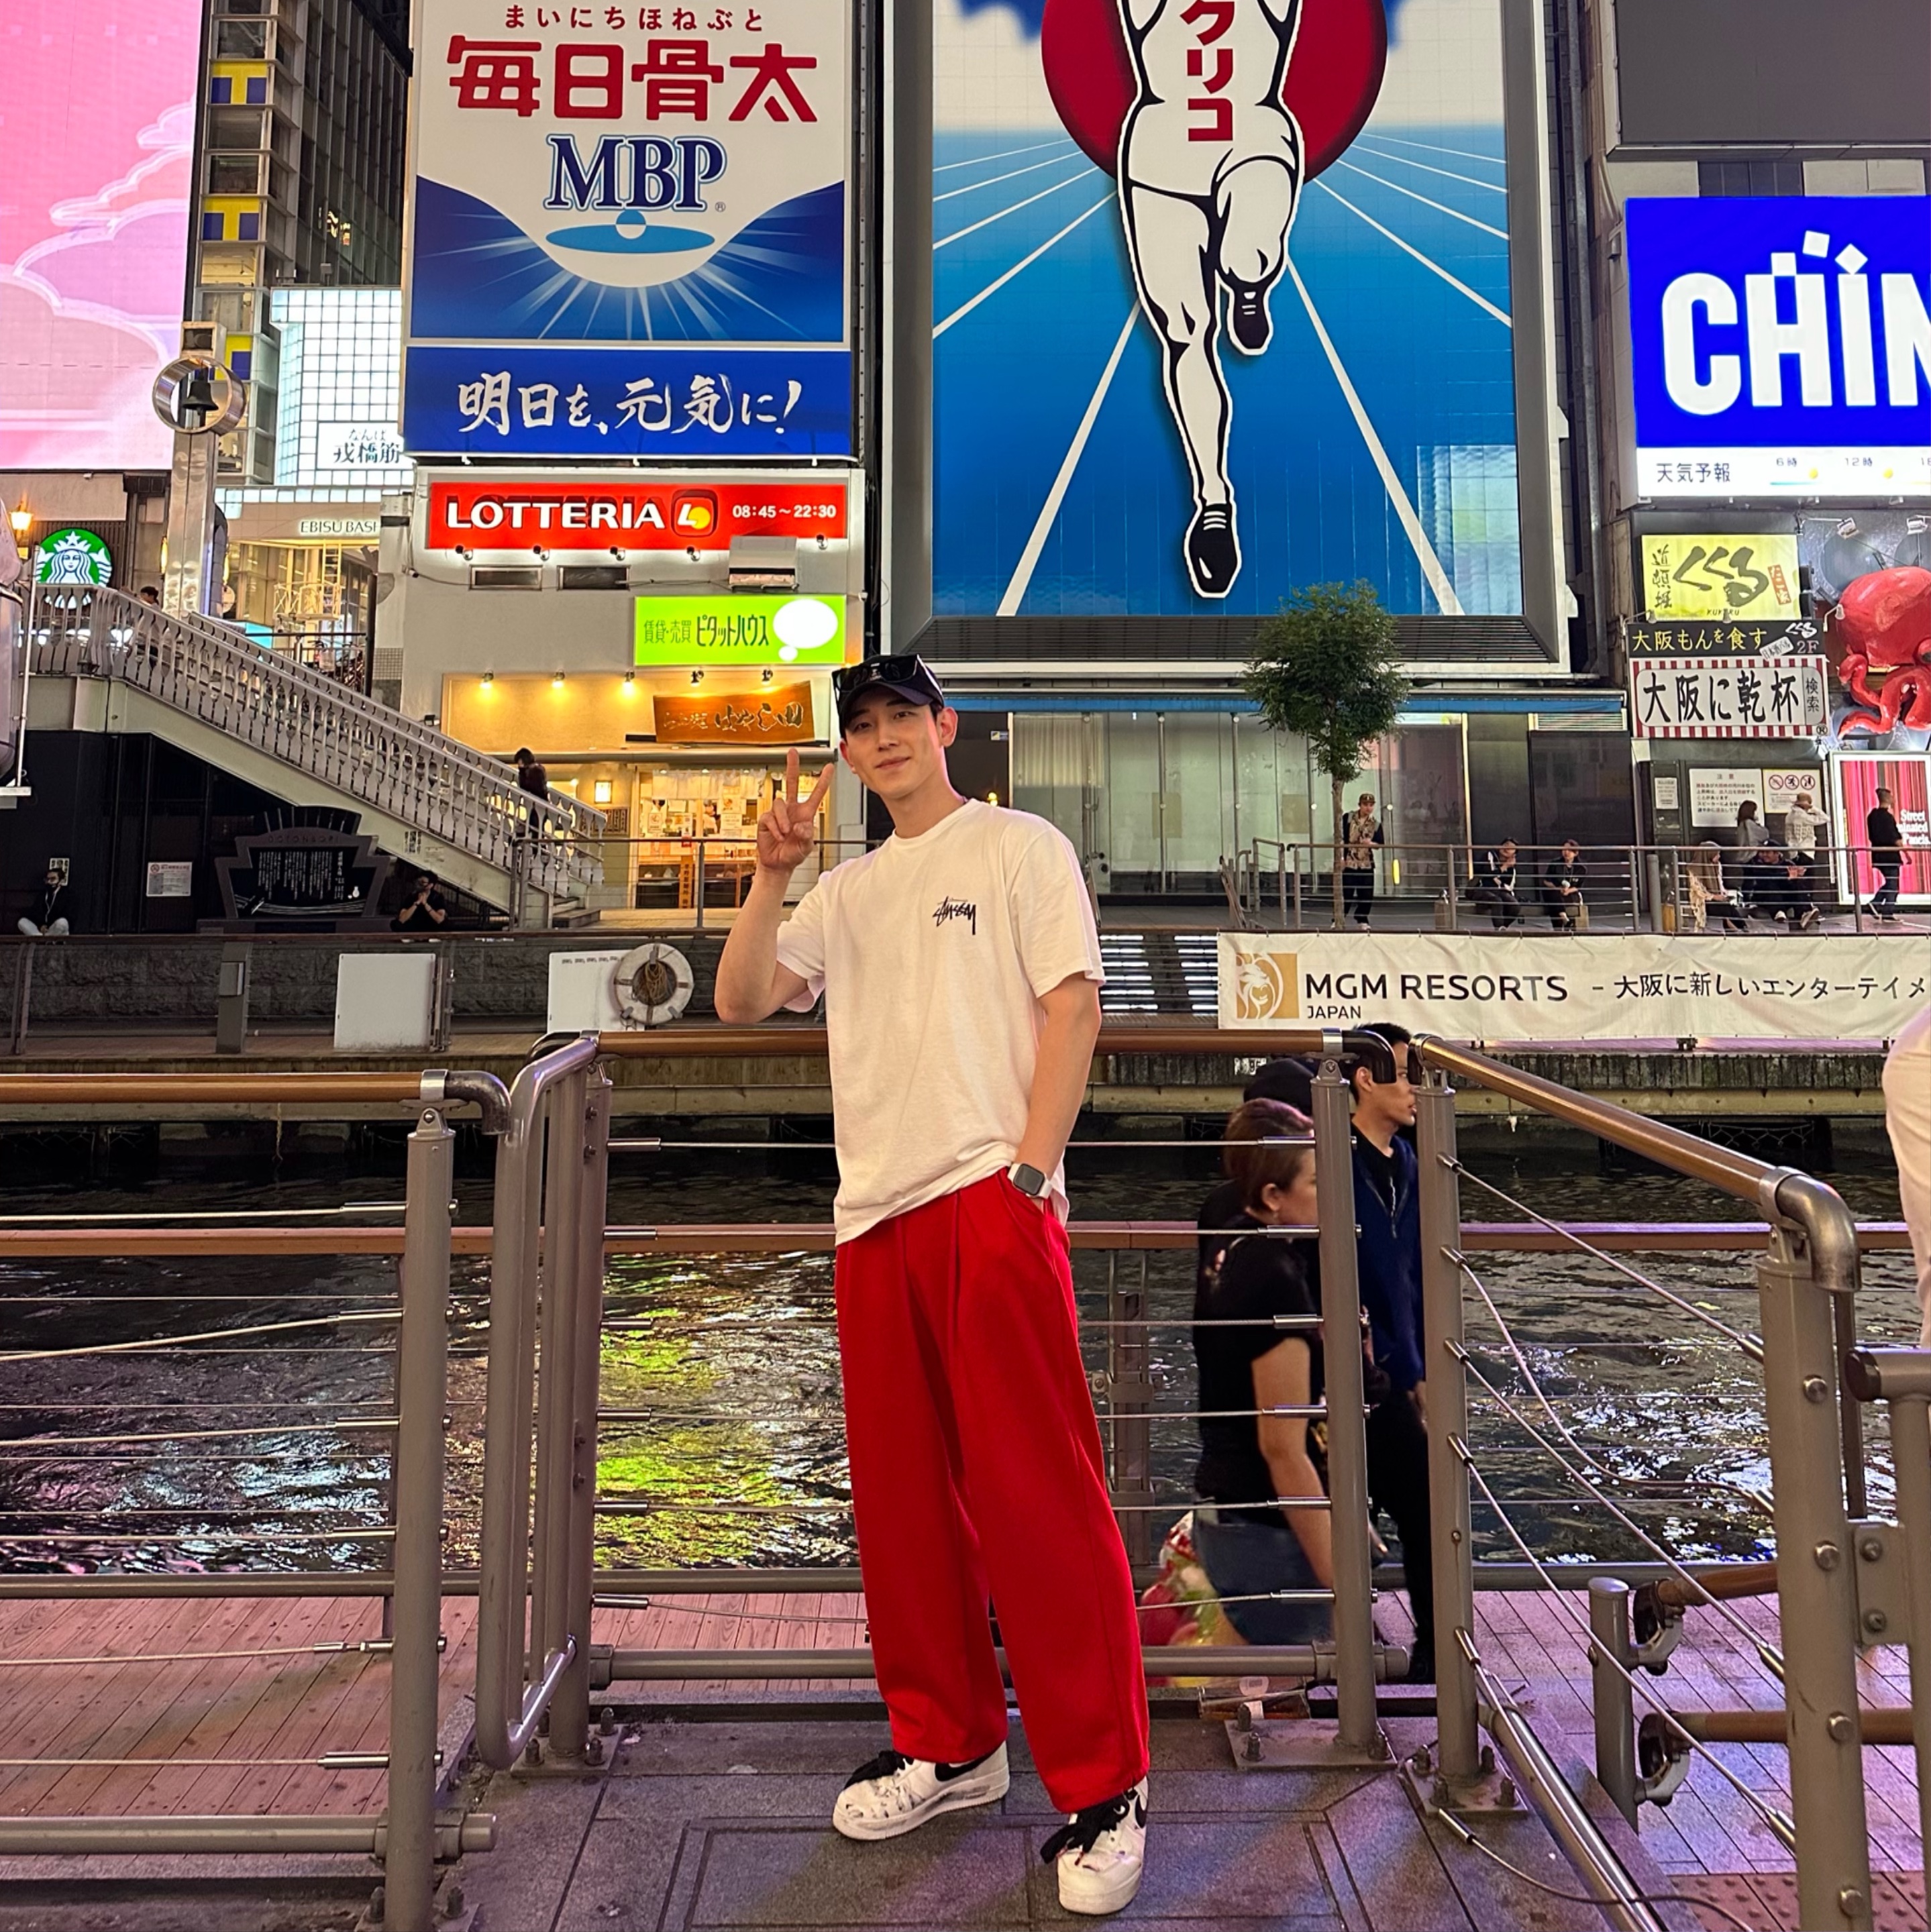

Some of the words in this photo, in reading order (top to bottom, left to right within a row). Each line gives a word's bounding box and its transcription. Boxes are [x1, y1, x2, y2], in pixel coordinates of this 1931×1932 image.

[505, 5, 764, 31] まいにちほねぶと
[447, 35, 817, 122] 毎日骨太
[543, 135, 727, 211] MBP
[349, 428, 387, 441] なんば
[333, 443, 400, 464] 戎橋筋
[1657, 462, 1730, 482] 天気予報
[301, 521, 342, 533] EBISU
[447, 502, 666, 530] LOTTERIA
[1673, 545, 1769, 607] くくる
[696, 614, 770, 647] ピタットハウス
[1632, 627, 1767, 651] 大阪もんを食す
[1797, 640, 1820, 653] 2F
[1642, 669, 1799, 724] 大阪に乾杯
[1805, 678, 1820, 712] 検索
[1900, 809, 1926, 822] Street
[1306, 973, 1388, 1000] MGM
[1402, 974, 1569, 1002] RESORTS
[1614, 972, 1926, 1000] 大阪に新しいエンターテイメ
[1307, 1005, 1362, 1020] JAPAN
